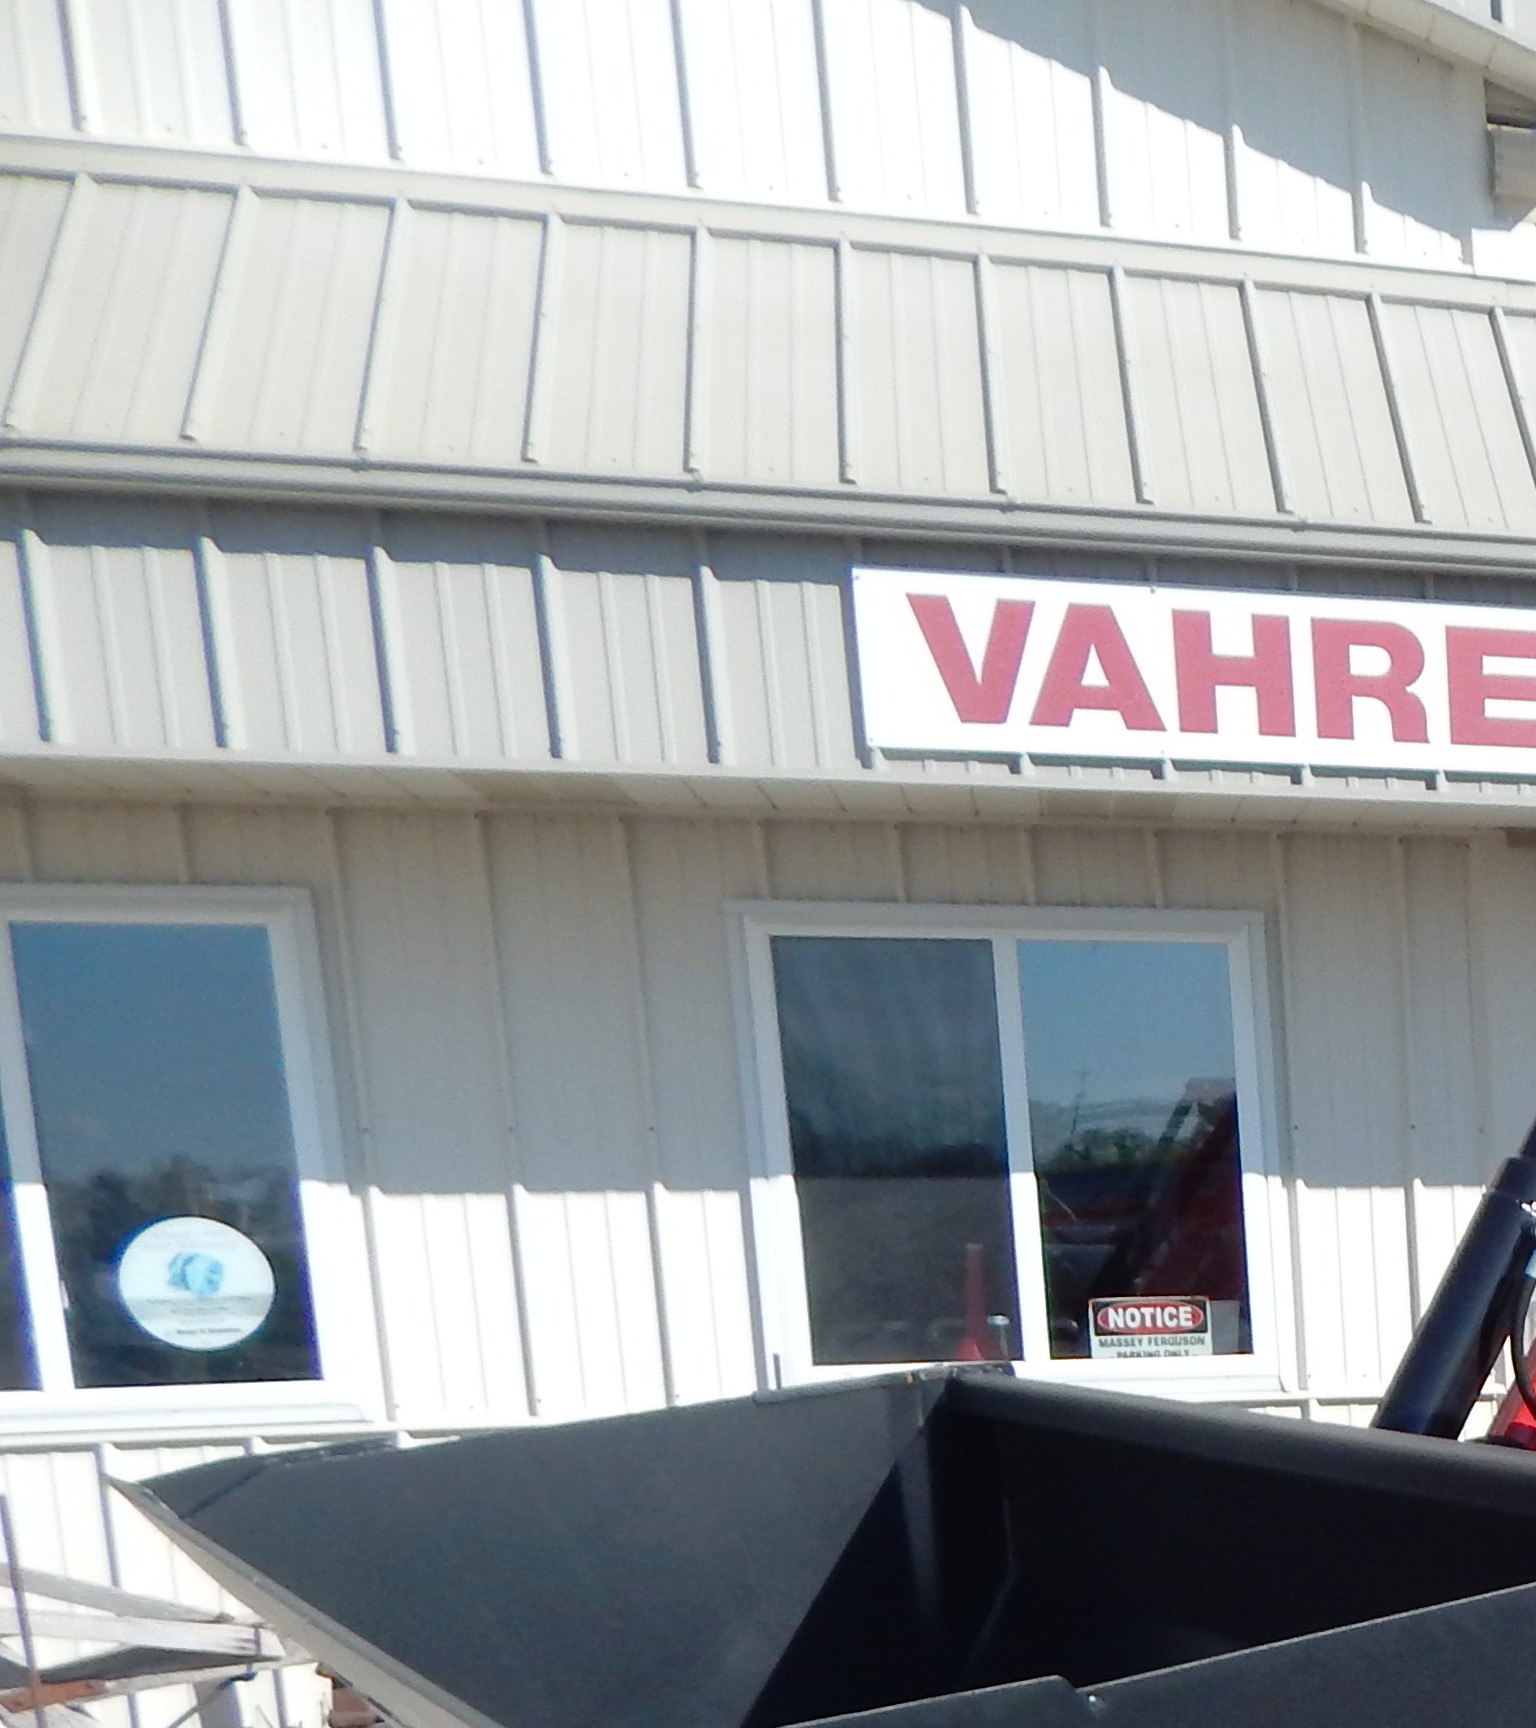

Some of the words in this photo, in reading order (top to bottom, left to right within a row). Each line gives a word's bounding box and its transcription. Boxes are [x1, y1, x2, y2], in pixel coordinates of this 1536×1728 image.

[1107, 1306, 1194, 1329] NOTICE
[1098, 1337, 1144, 1348] MASSEY
[1147, 1335, 1206, 1347] FERGUSON
